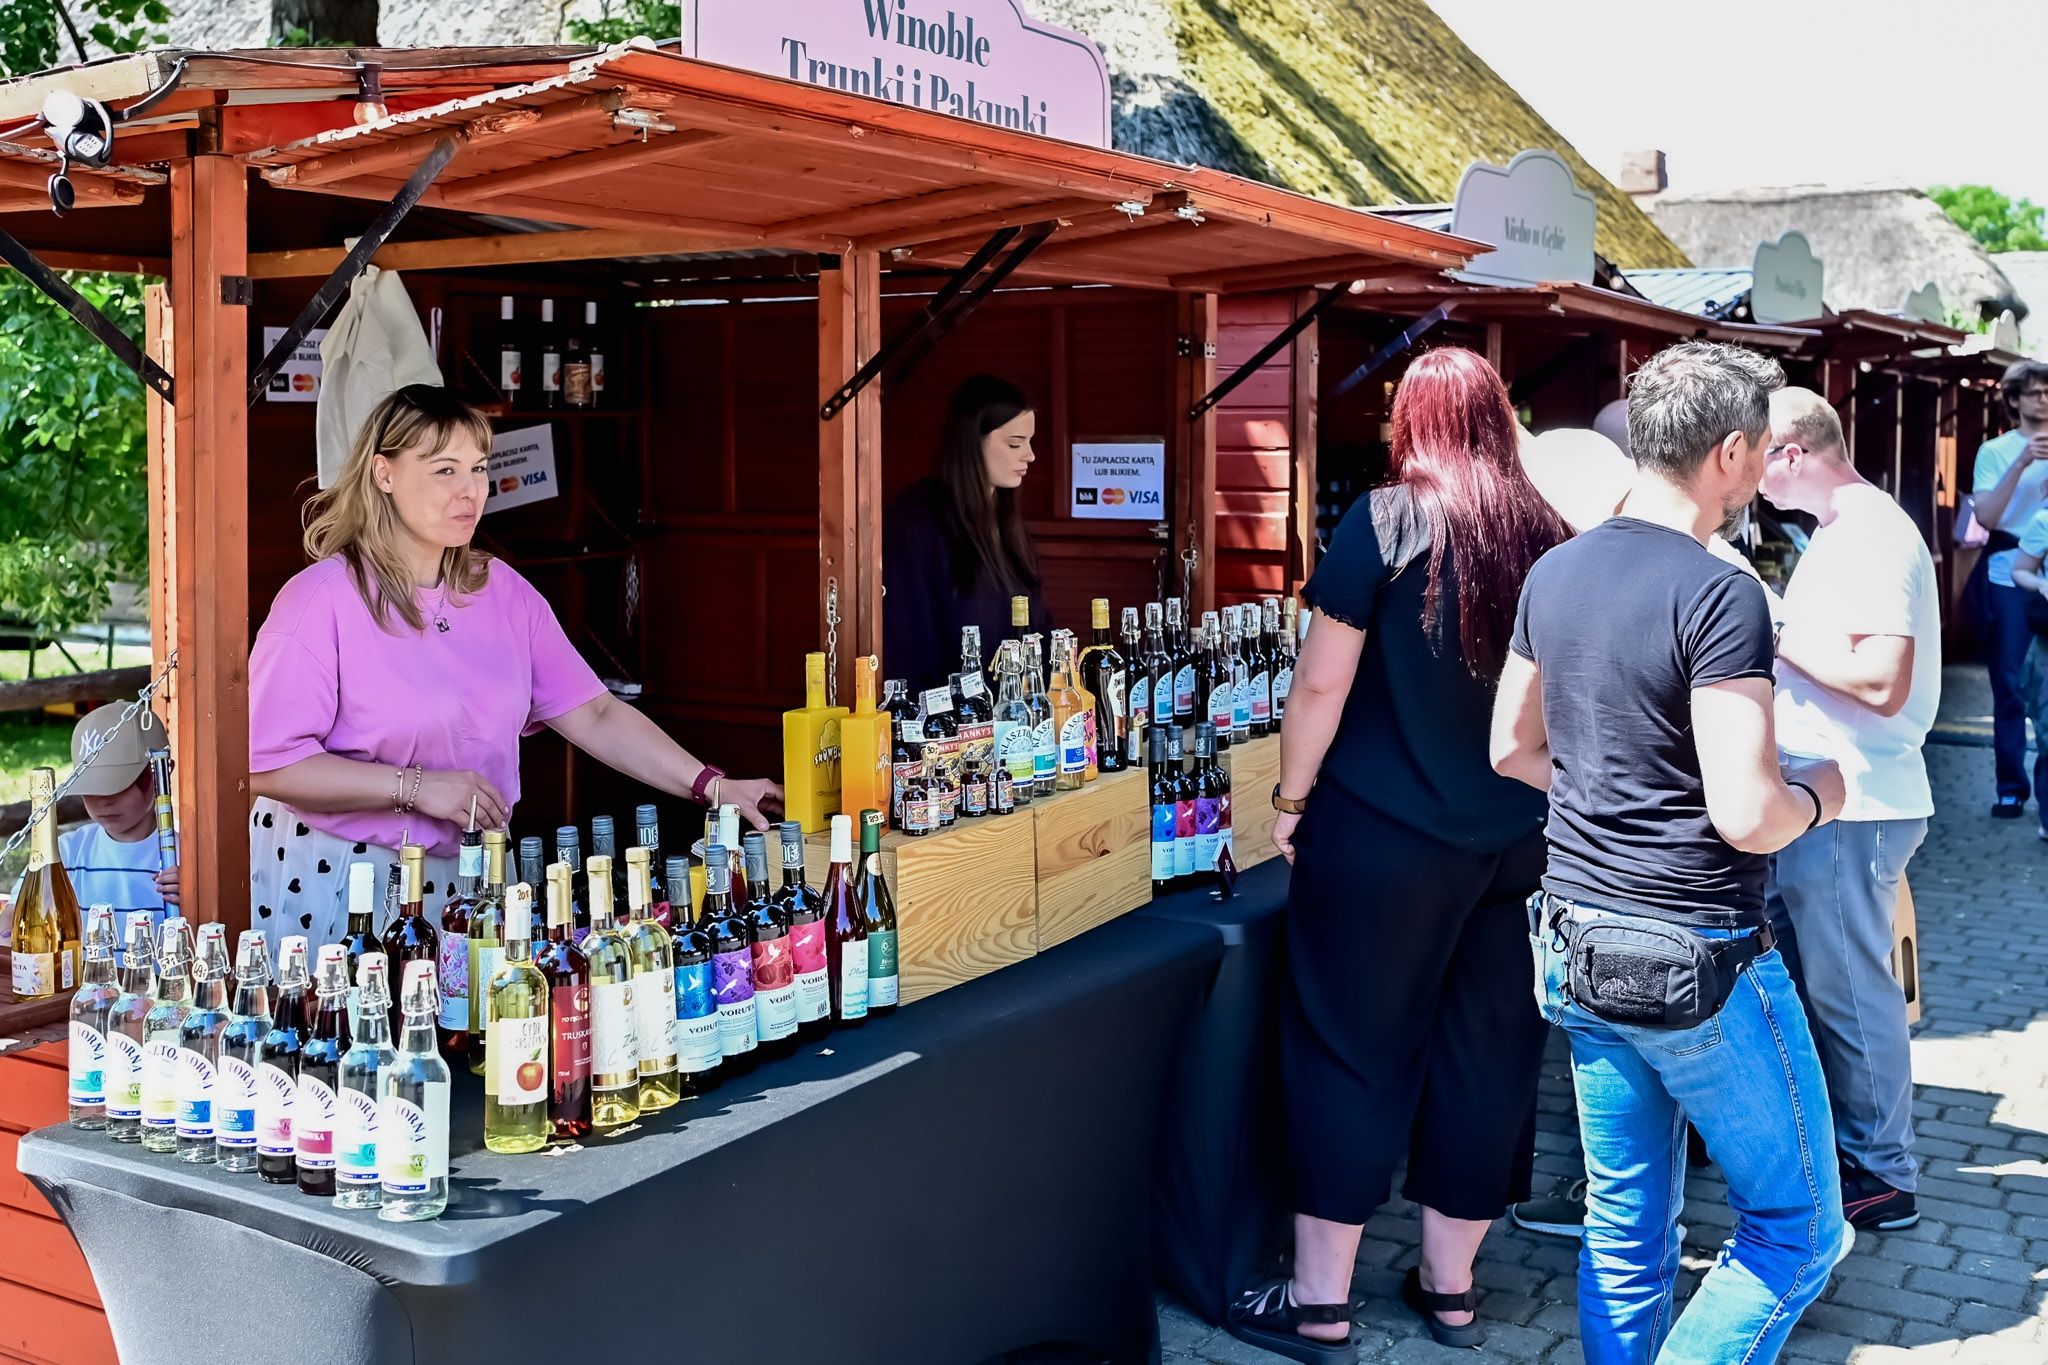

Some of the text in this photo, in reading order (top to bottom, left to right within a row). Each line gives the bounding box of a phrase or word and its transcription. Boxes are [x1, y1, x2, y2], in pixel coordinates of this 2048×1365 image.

[861, 0, 991, 68] Winoble
[781, 37, 1047, 135] Trunki i Pakunki
[1082, 456, 1155, 466] TU ZAPŁACISZ KARTĄ
[521, 470, 547, 486] VISA
[1128, 490, 1160, 504] VISA
